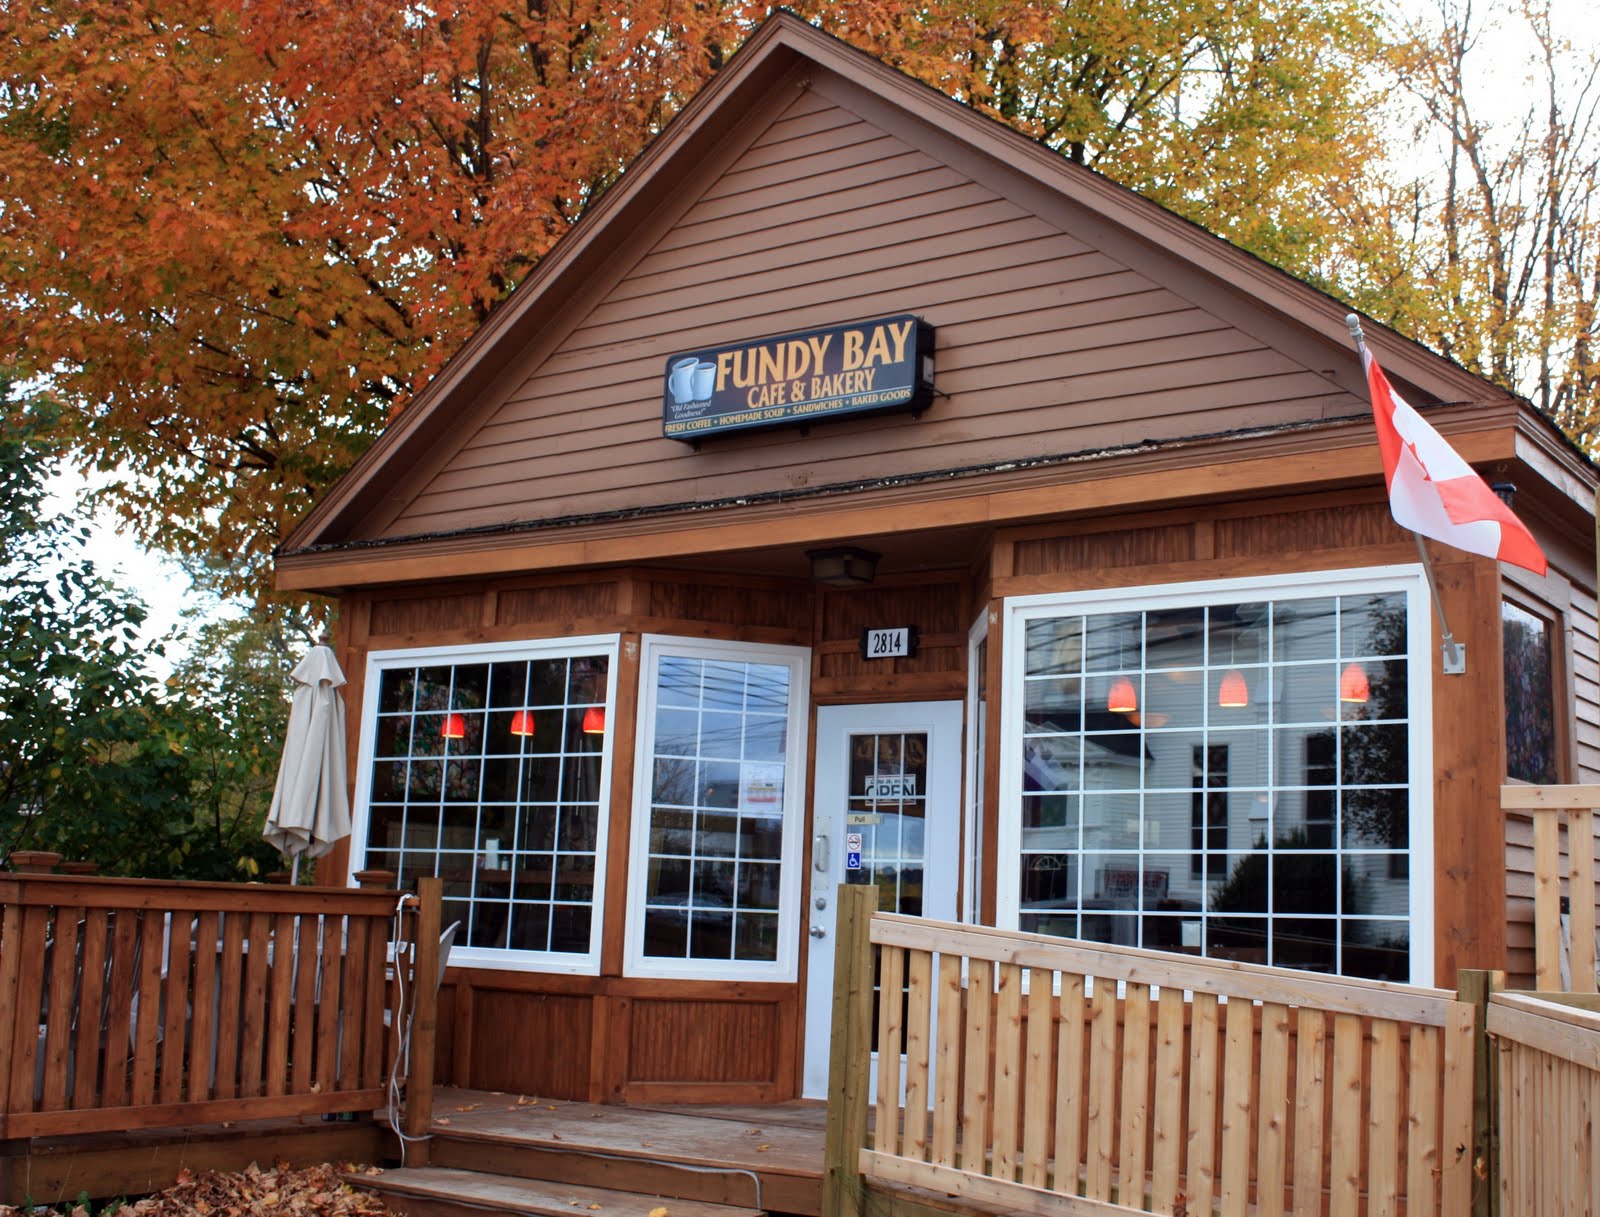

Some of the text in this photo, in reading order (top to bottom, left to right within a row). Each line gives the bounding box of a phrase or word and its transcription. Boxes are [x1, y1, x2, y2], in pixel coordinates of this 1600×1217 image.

[716, 320, 914, 392] FUNDY BAY
[747, 368, 876, 409] CAFE & BAKERY
[665, 389, 911, 433] FRESH COFFEE HOMEMADE SOUP SANDWICHES BAKED GOODS
[684, 400, 712, 411] Fashioned
[873, 631, 902, 653] 2814
[866, 784, 914, 801] OPEN
